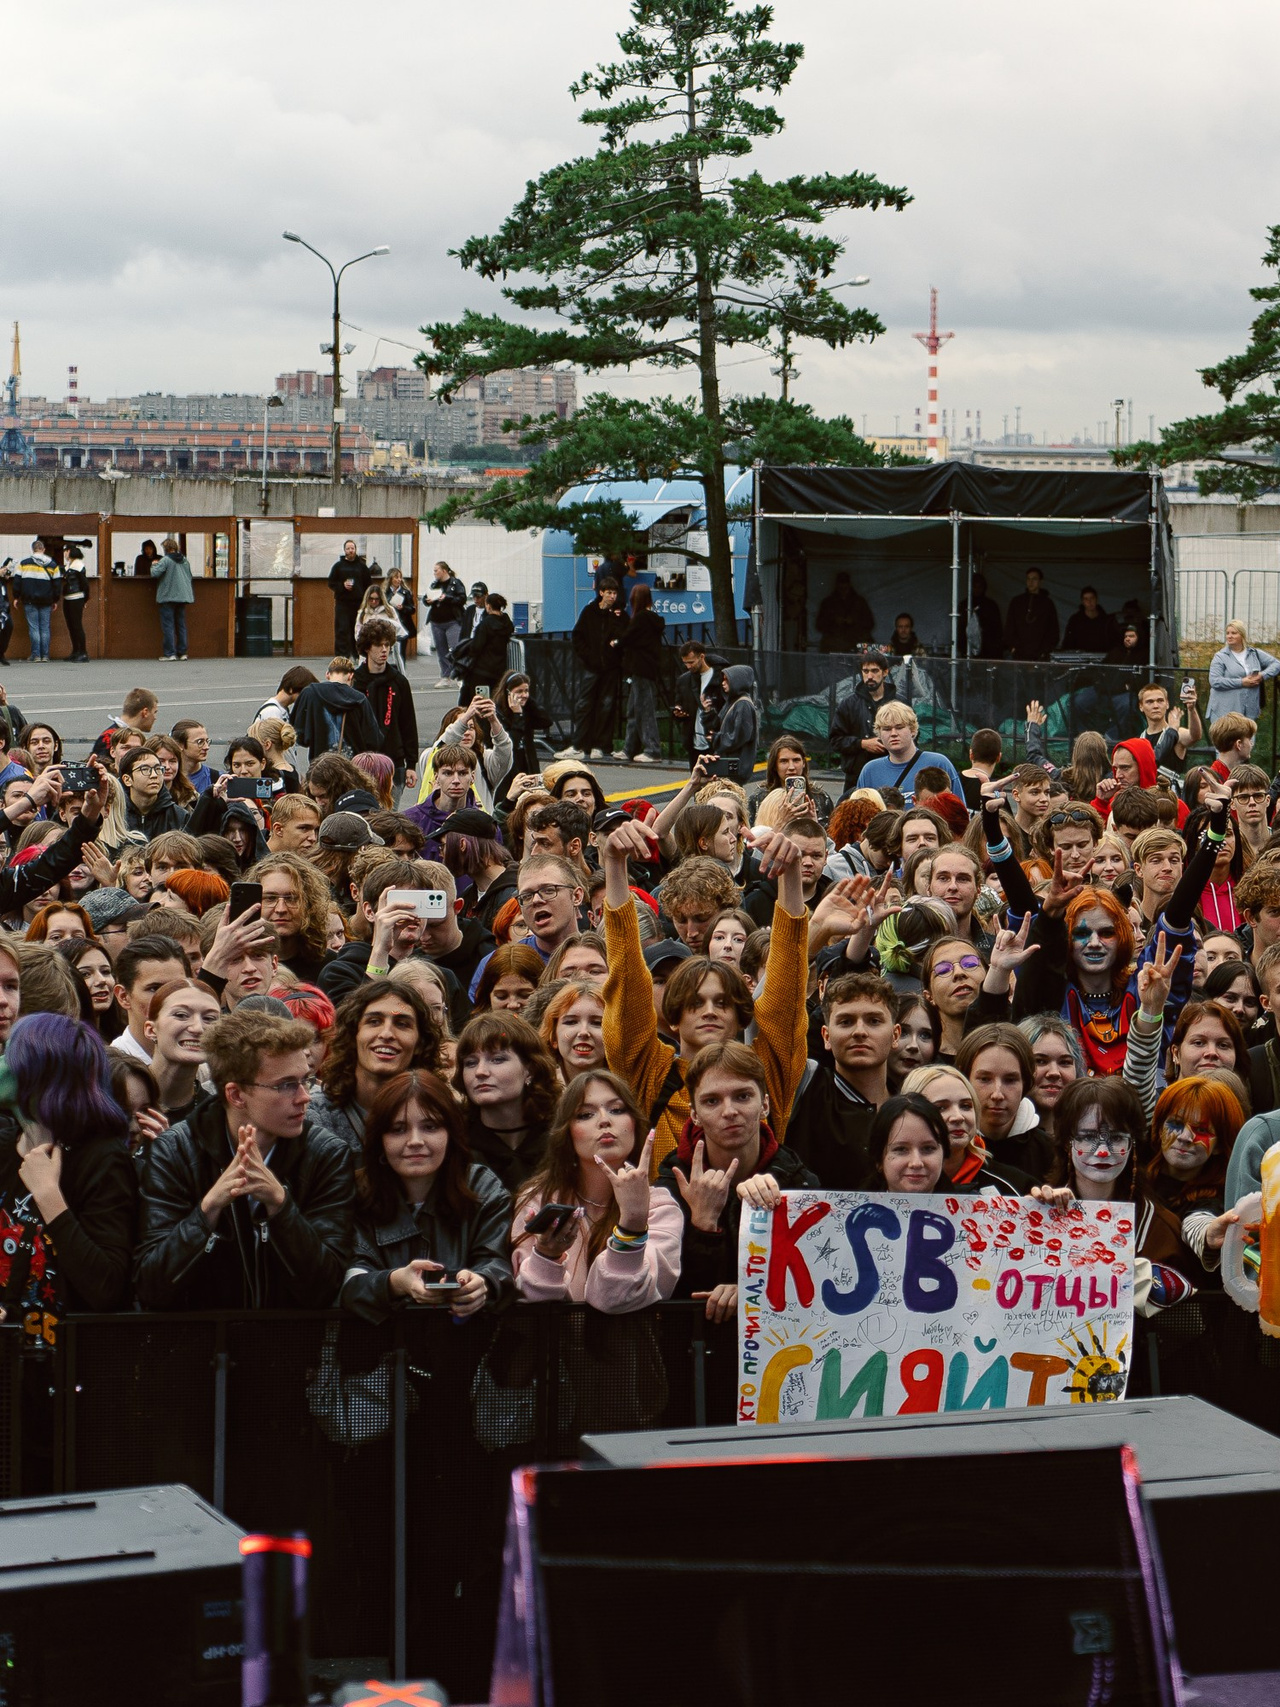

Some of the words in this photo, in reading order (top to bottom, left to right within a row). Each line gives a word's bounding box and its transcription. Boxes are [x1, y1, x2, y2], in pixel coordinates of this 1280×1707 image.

[749, 1205, 769, 1235] ГЕ
[746, 1240, 768, 1278] ТОТ
[766, 1195, 958, 1315] KSB
[996, 1268, 1118, 1317] ОТЦЫ
[739, 1383, 757, 1422] КТО
